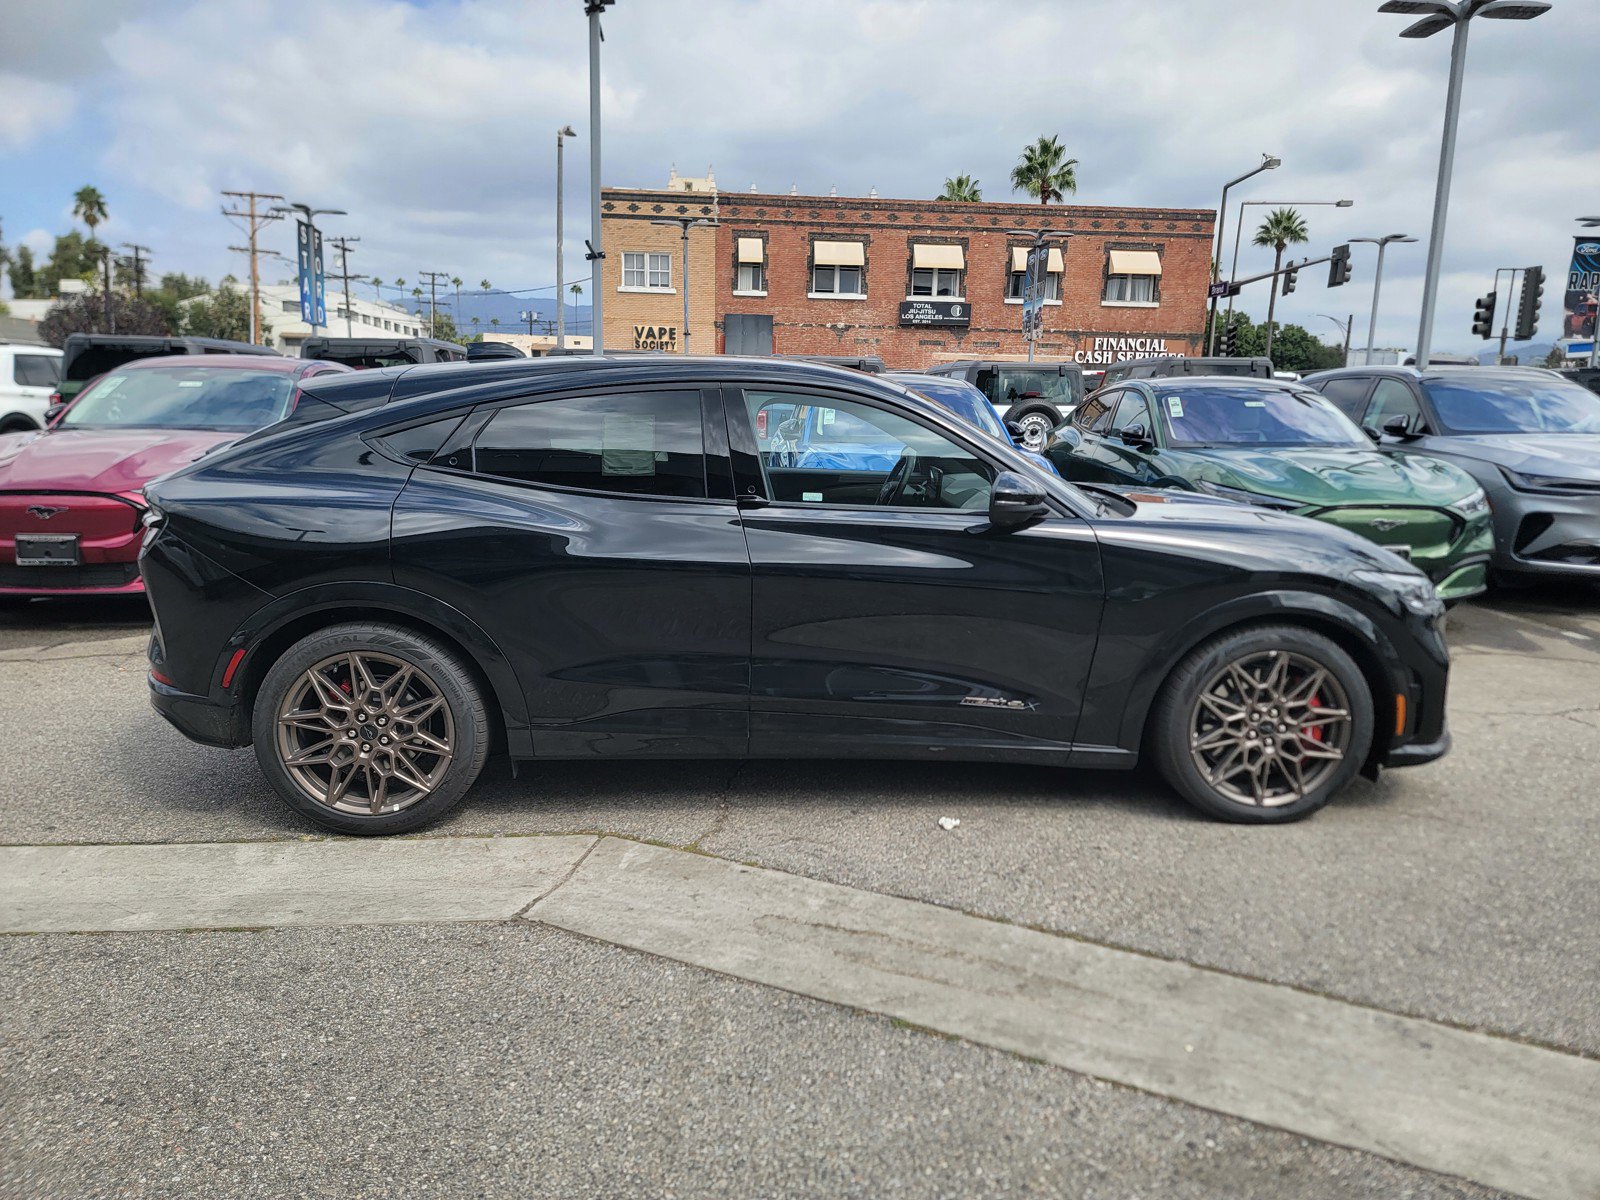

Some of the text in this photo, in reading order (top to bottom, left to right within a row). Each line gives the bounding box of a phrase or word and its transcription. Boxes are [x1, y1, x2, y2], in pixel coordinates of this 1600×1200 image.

[300, 225, 312, 321] STAR
[314, 231, 324, 323] FORD
[1211, 284, 1225, 295] Brand
[634, 326, 676, 340] VAPE
[634, 340, 676, 350] SOCIETY
[1094, 337, 1168, 352] FINANCIAL
[1074, 350, 1185, 364] CASH SERV
